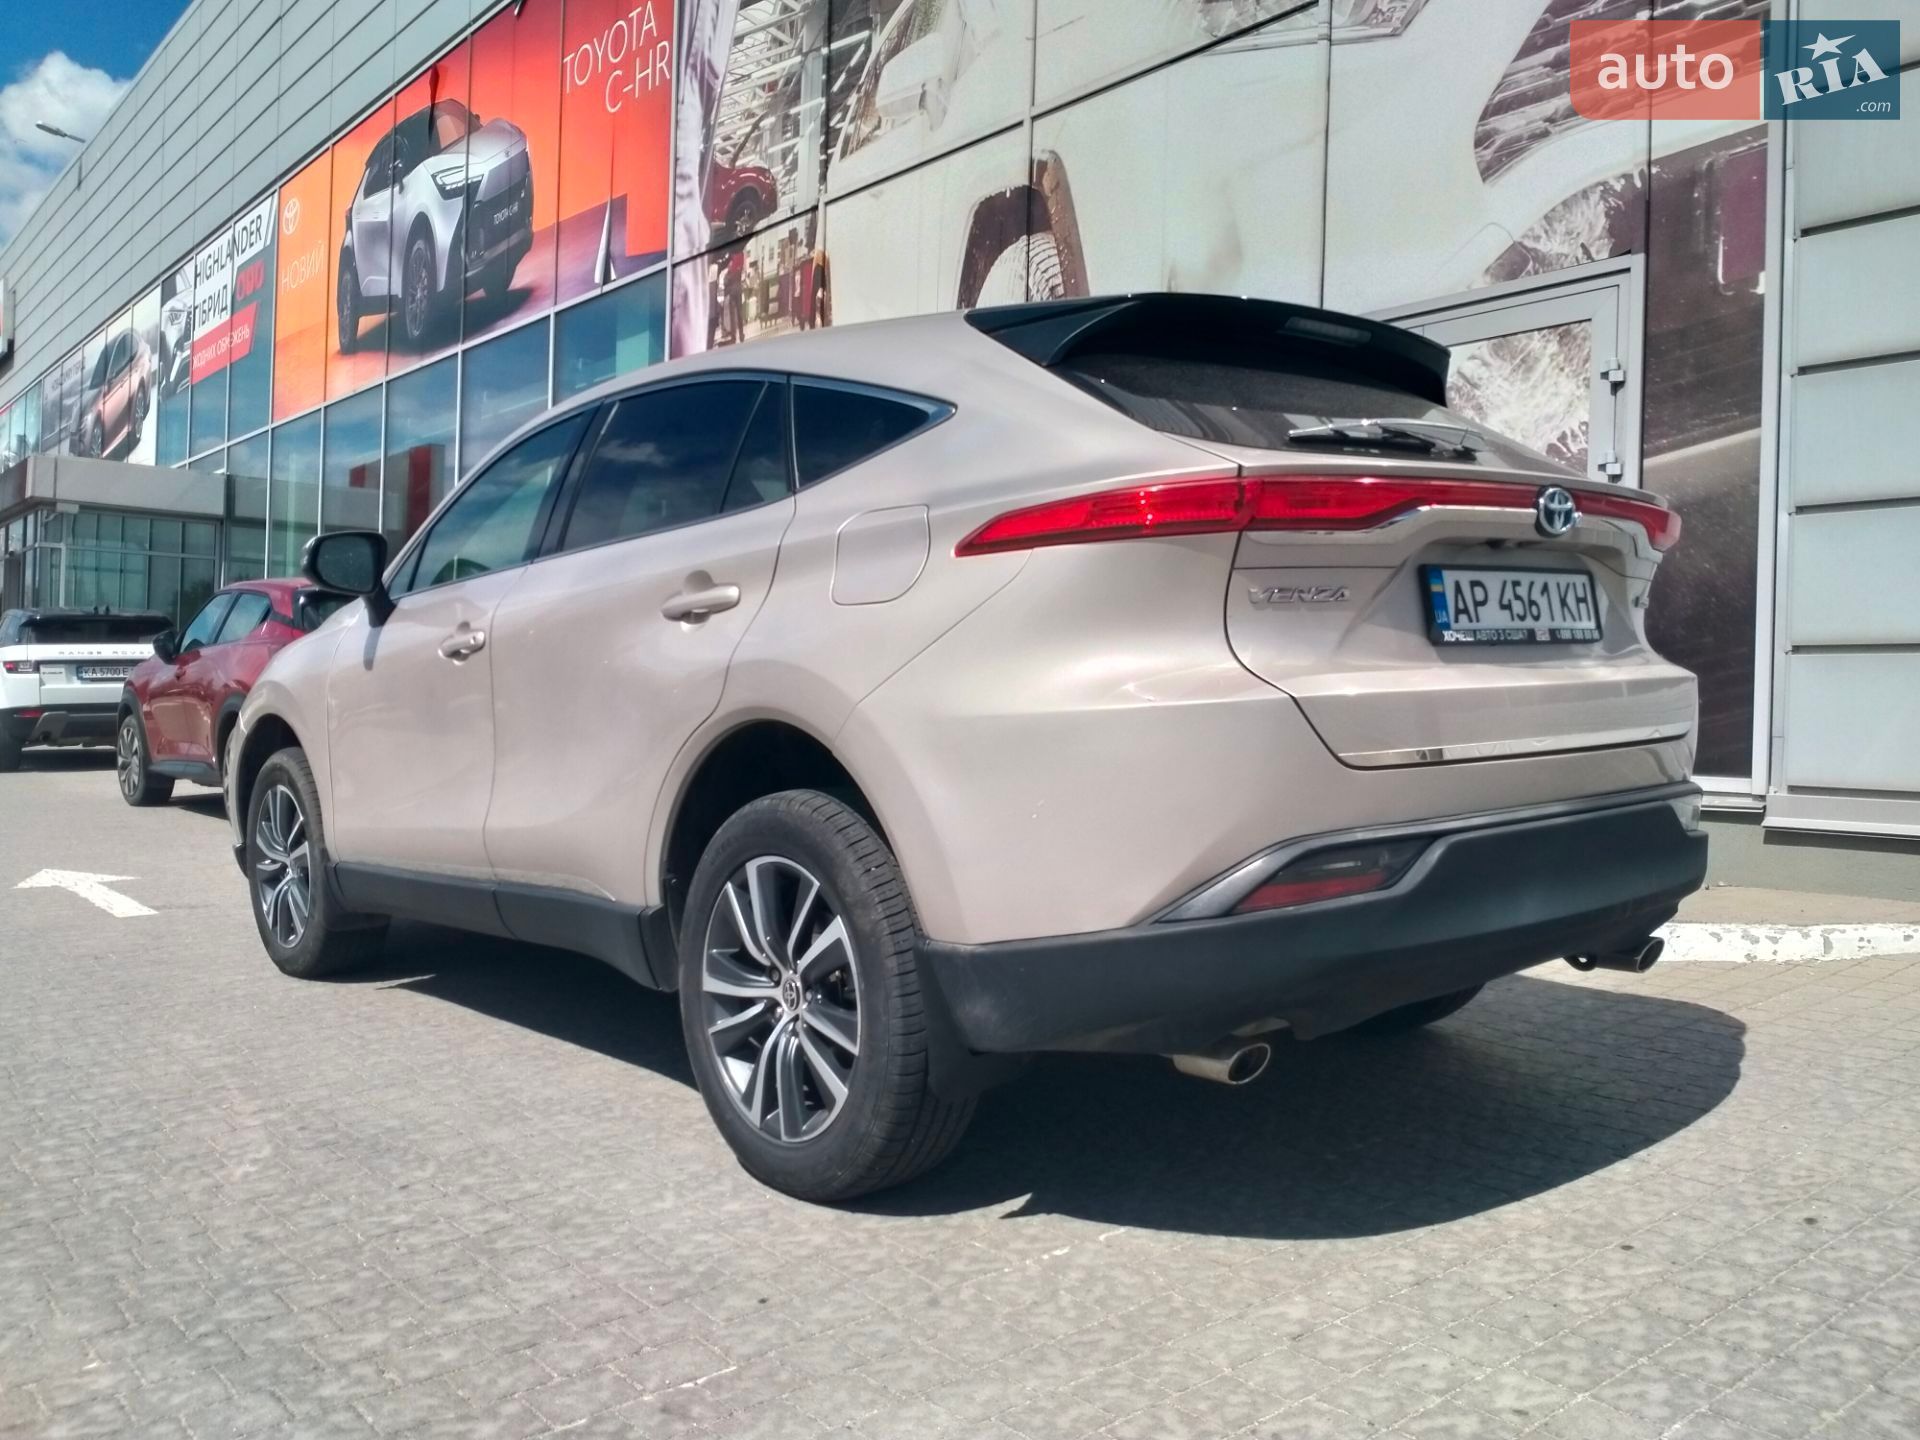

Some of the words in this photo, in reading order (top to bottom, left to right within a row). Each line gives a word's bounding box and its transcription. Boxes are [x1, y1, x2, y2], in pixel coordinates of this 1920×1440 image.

[563, 0, 657, 94] TOYOTA
[605, 40, 671, 113] C-HR
[194, 213, 263, 290] HIGHLANDER
[281, 239, 325, 294] НОВИЙ
[1248, 586, 1350, 605] VENZA
[1435, 610, 1448, 623] UA
[1453, 580, 1489, 624] AP
[1498, 580, 1555, 623] 4561
[1557, 581, 1592, 623] KH
